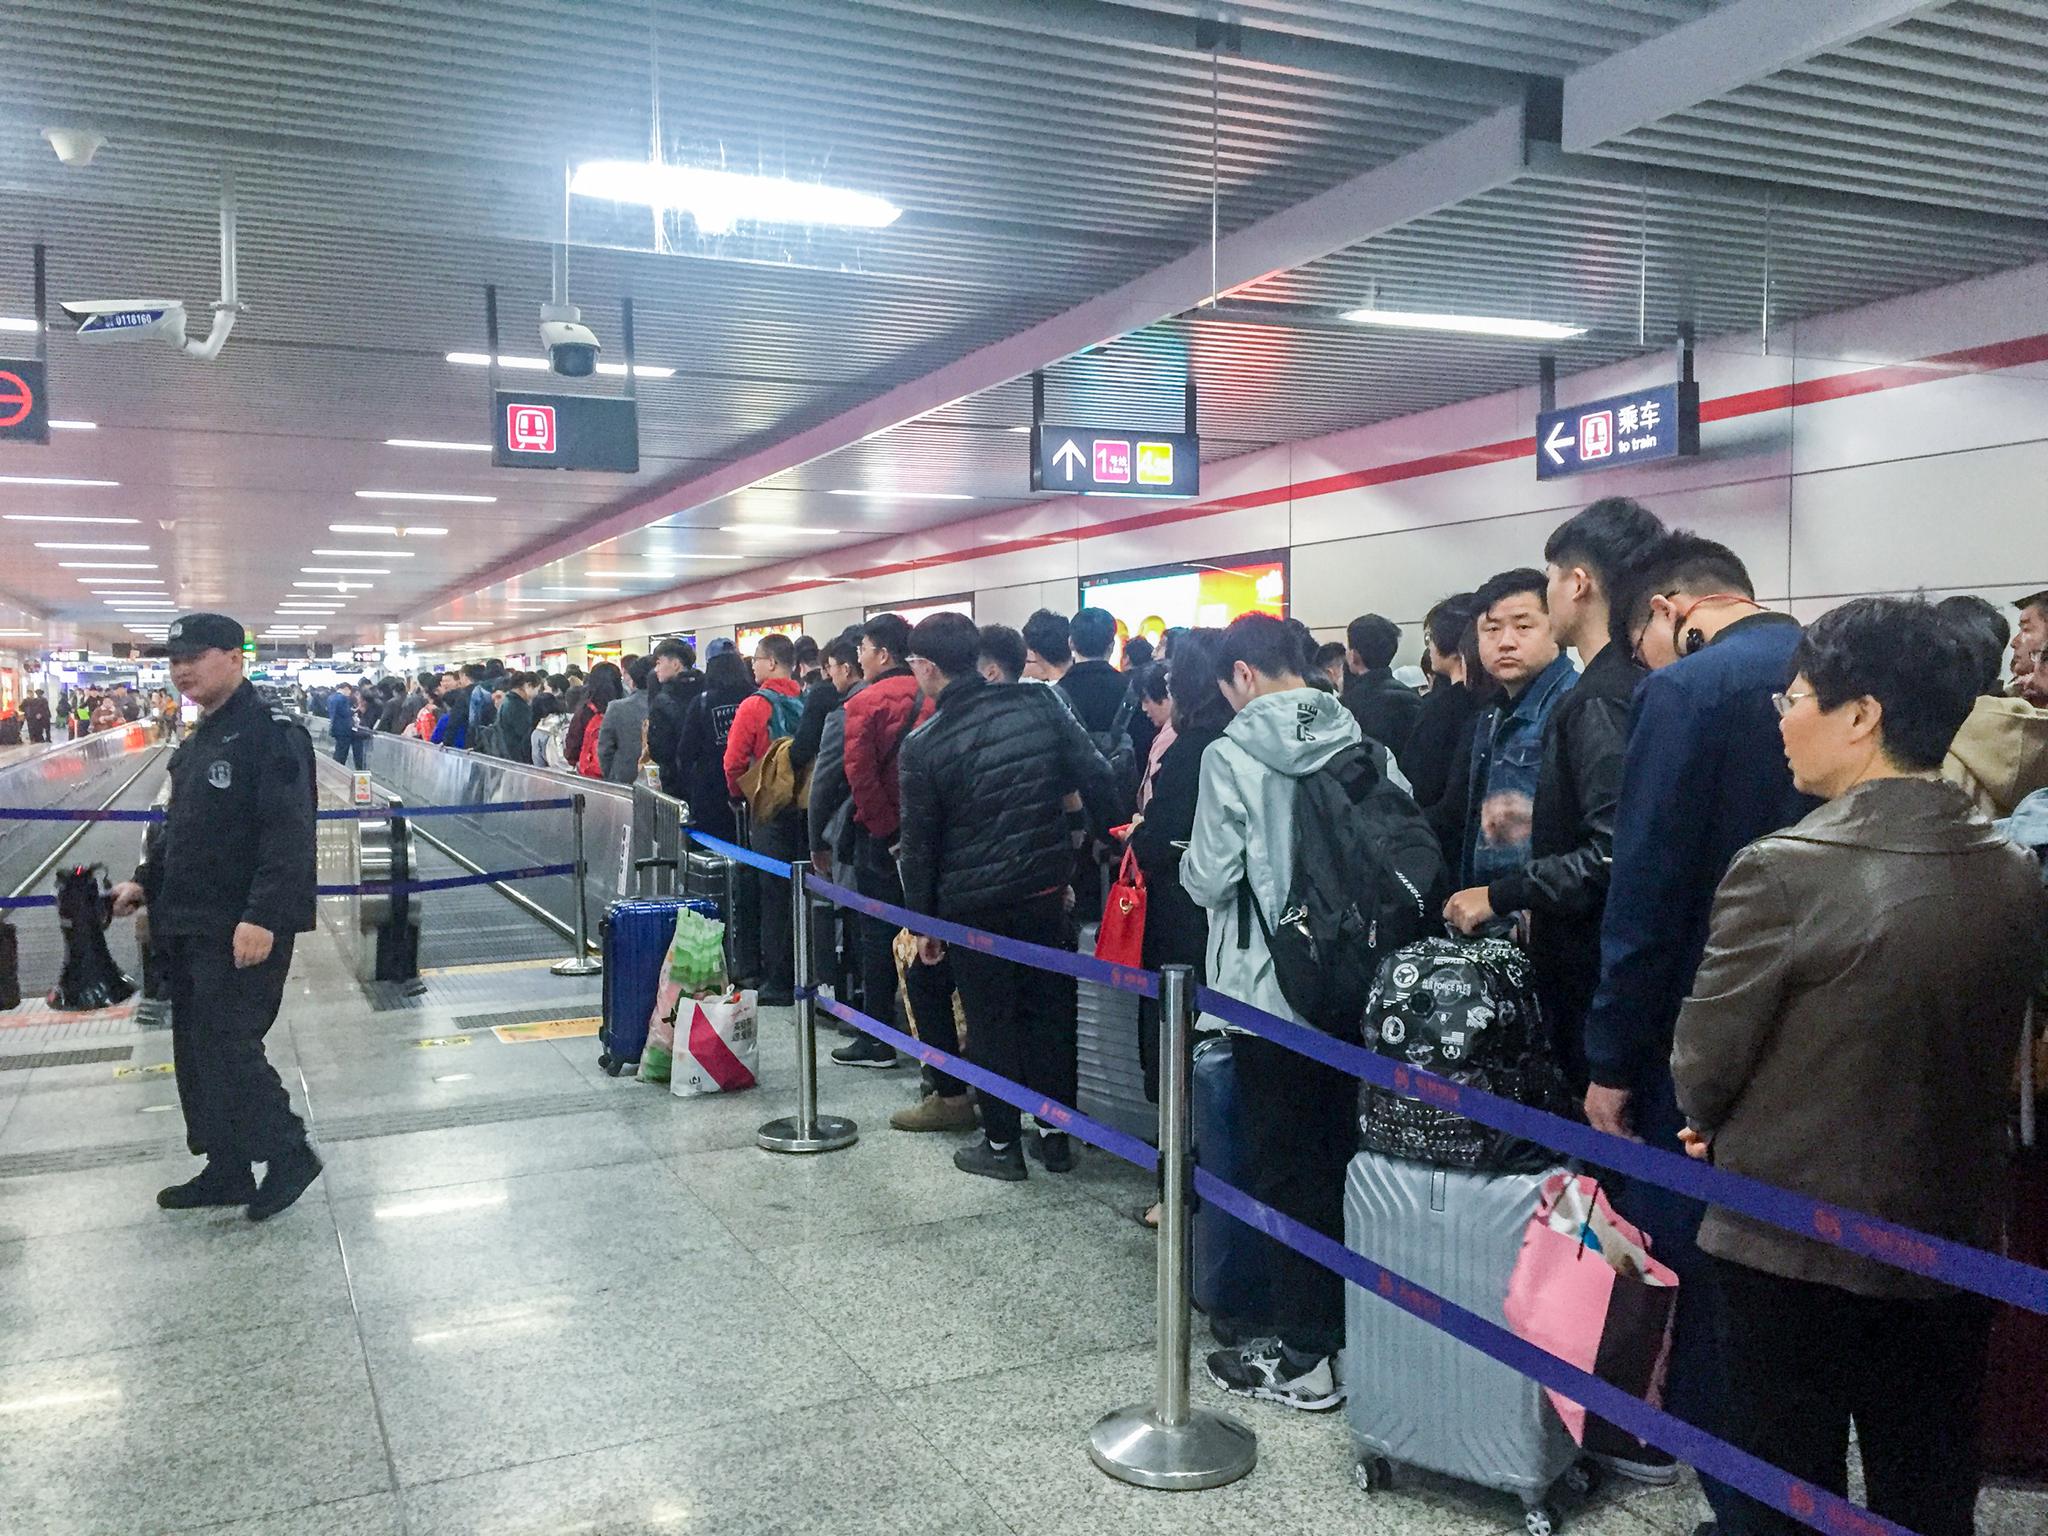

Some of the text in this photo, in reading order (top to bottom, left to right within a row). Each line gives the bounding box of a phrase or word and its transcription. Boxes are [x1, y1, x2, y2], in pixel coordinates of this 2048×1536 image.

[1618, 400, 1661, 434] 乘车
[1618, 434, 1658, 453] to train
